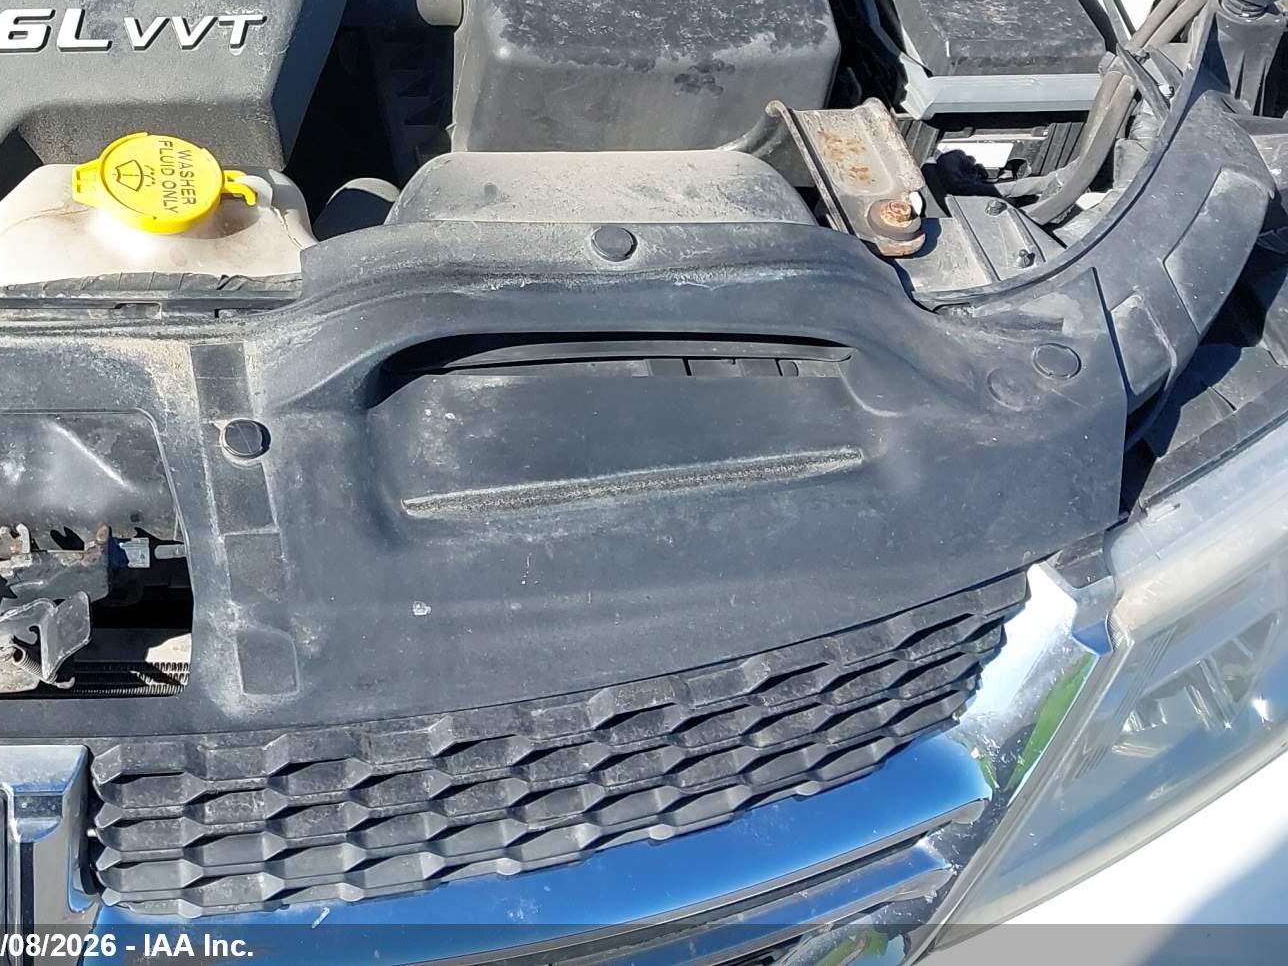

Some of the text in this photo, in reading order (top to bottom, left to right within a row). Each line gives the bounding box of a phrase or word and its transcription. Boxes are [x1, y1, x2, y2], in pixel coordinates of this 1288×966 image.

[123, 14, 267, 51] VVT
[159, 140, 178, 213] FLUID ONLY
[178, 149, 197, 205] WASHER
